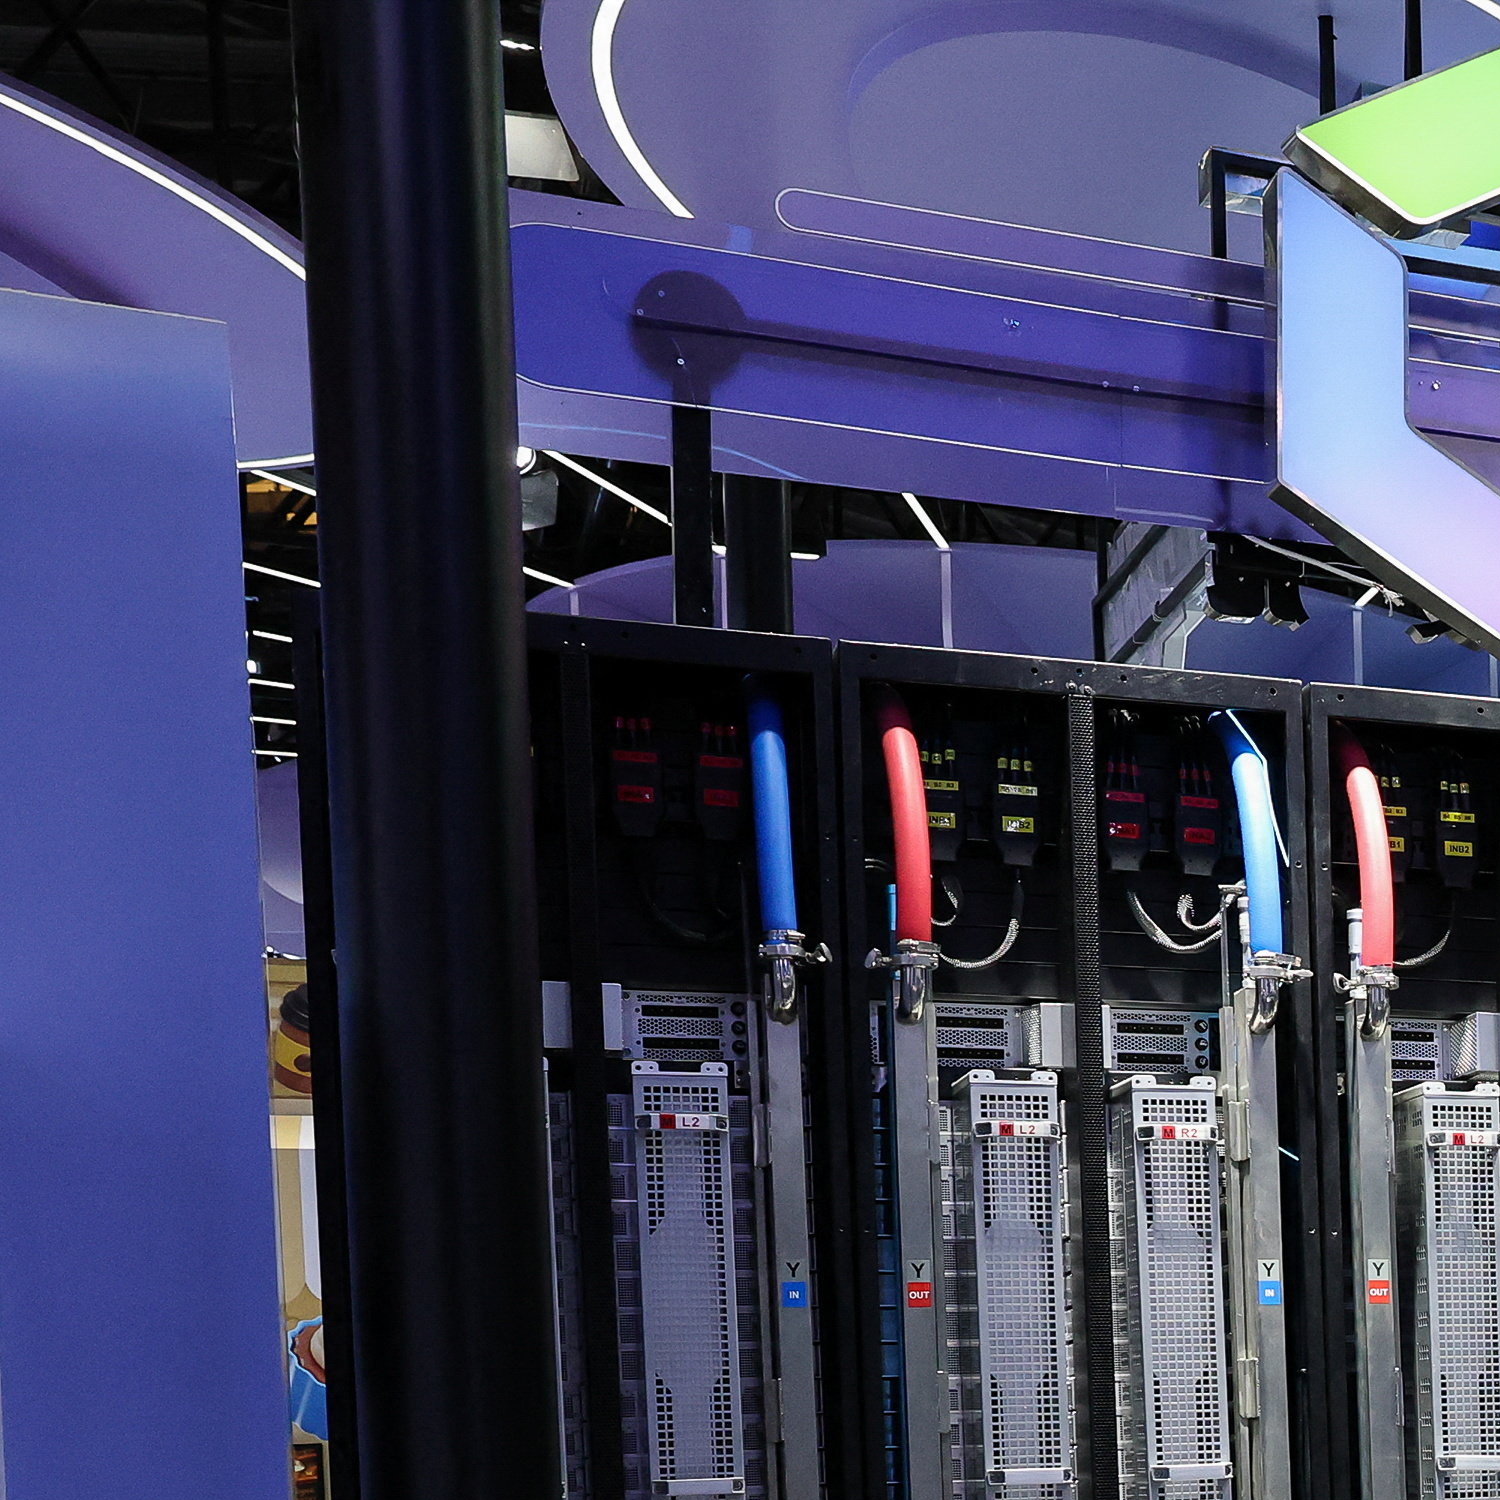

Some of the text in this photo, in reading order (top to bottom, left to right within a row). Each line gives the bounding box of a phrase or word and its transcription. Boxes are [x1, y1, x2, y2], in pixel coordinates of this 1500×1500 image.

[1449, 845, 1470, 854] INB2
[682, 1117, 699, 1127] L2
[1020, 1125, 1035, 1134] L2
[1182, 1129, 1197, 1138] R2
[1471, 1135, 1484, 1144] L2
[786, 1262, 799, 1278] Y
[911, 1262, 925, 1278] Y
[1262, 1262, 1276, 1277] Y
[1372, 1262, 1384, 1276] Y
[789, 1290, 799, 1299] IN
[909, 1291, 930, 1299] OUT
[1264, 1289, 1274, 1297] IN
[1370, 1288, 1388, 1296] OUT
